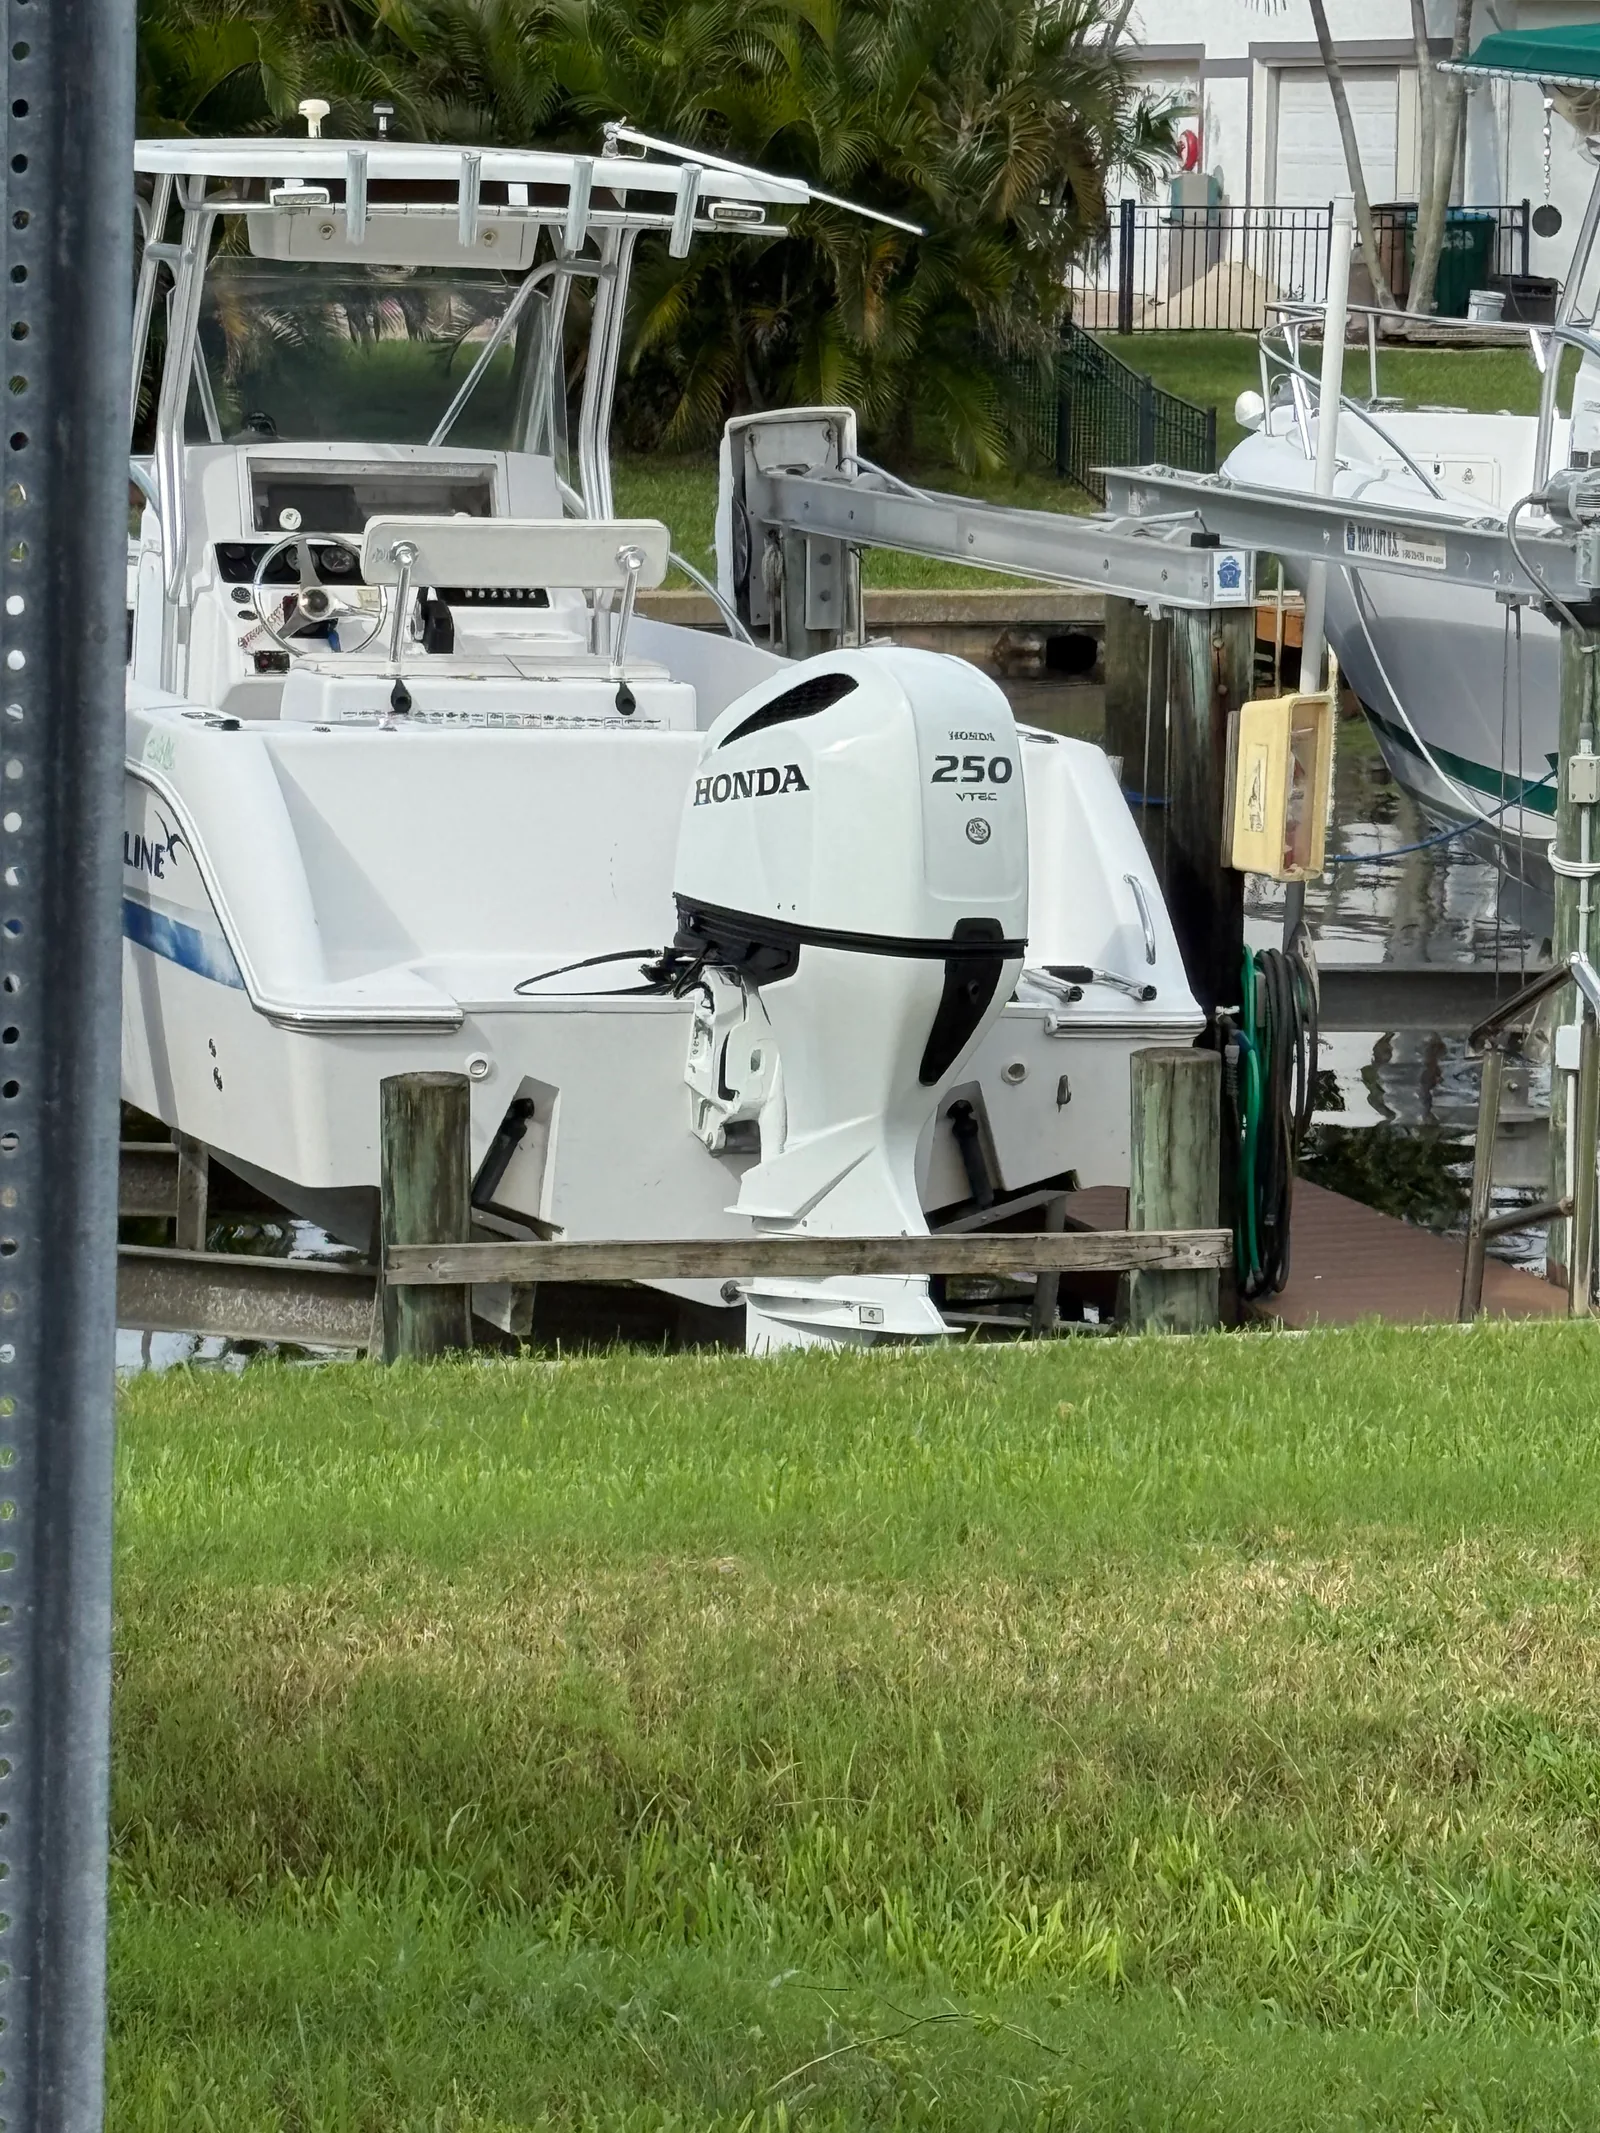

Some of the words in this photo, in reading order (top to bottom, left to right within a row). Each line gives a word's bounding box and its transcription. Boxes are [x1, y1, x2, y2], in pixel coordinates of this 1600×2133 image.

[948, 731, 996, 742] HONDA
[930, 755, 1013, 784] 250
[693, 763, 811, 806] HONDA
[955, 792, 998, 802] VTEC
[124, 831, 165, 880] LINE
